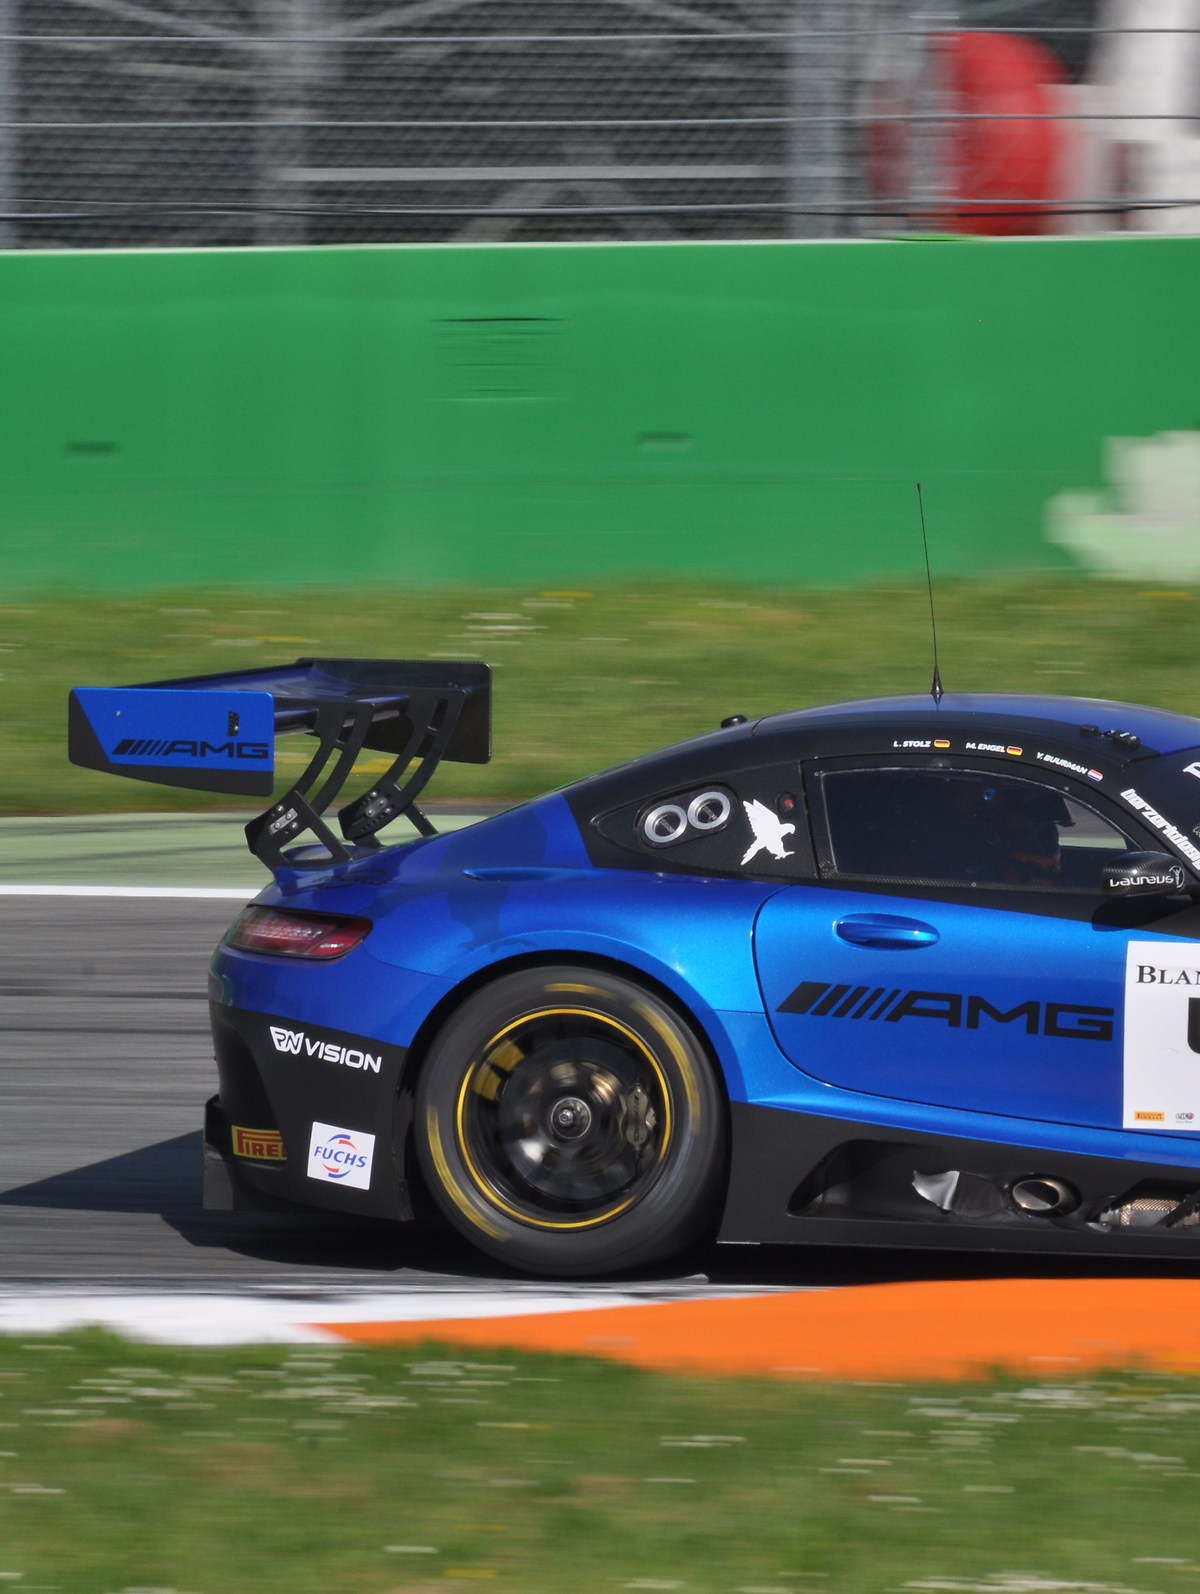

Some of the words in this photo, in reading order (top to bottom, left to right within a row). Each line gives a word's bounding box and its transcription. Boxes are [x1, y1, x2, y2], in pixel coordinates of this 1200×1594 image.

[163, 740, 269, 760] AMG
[902, 740, 932, 748] STOLZ
[977, 743, 1006, 753] ENGEL
[1043, 754, 1088, 775] BUURMAN
[884, 990, 1114, 1041] AMG
[305, 1037, 382, 1074] VISION
[313, 1146, 368, 1168] FUCHS
